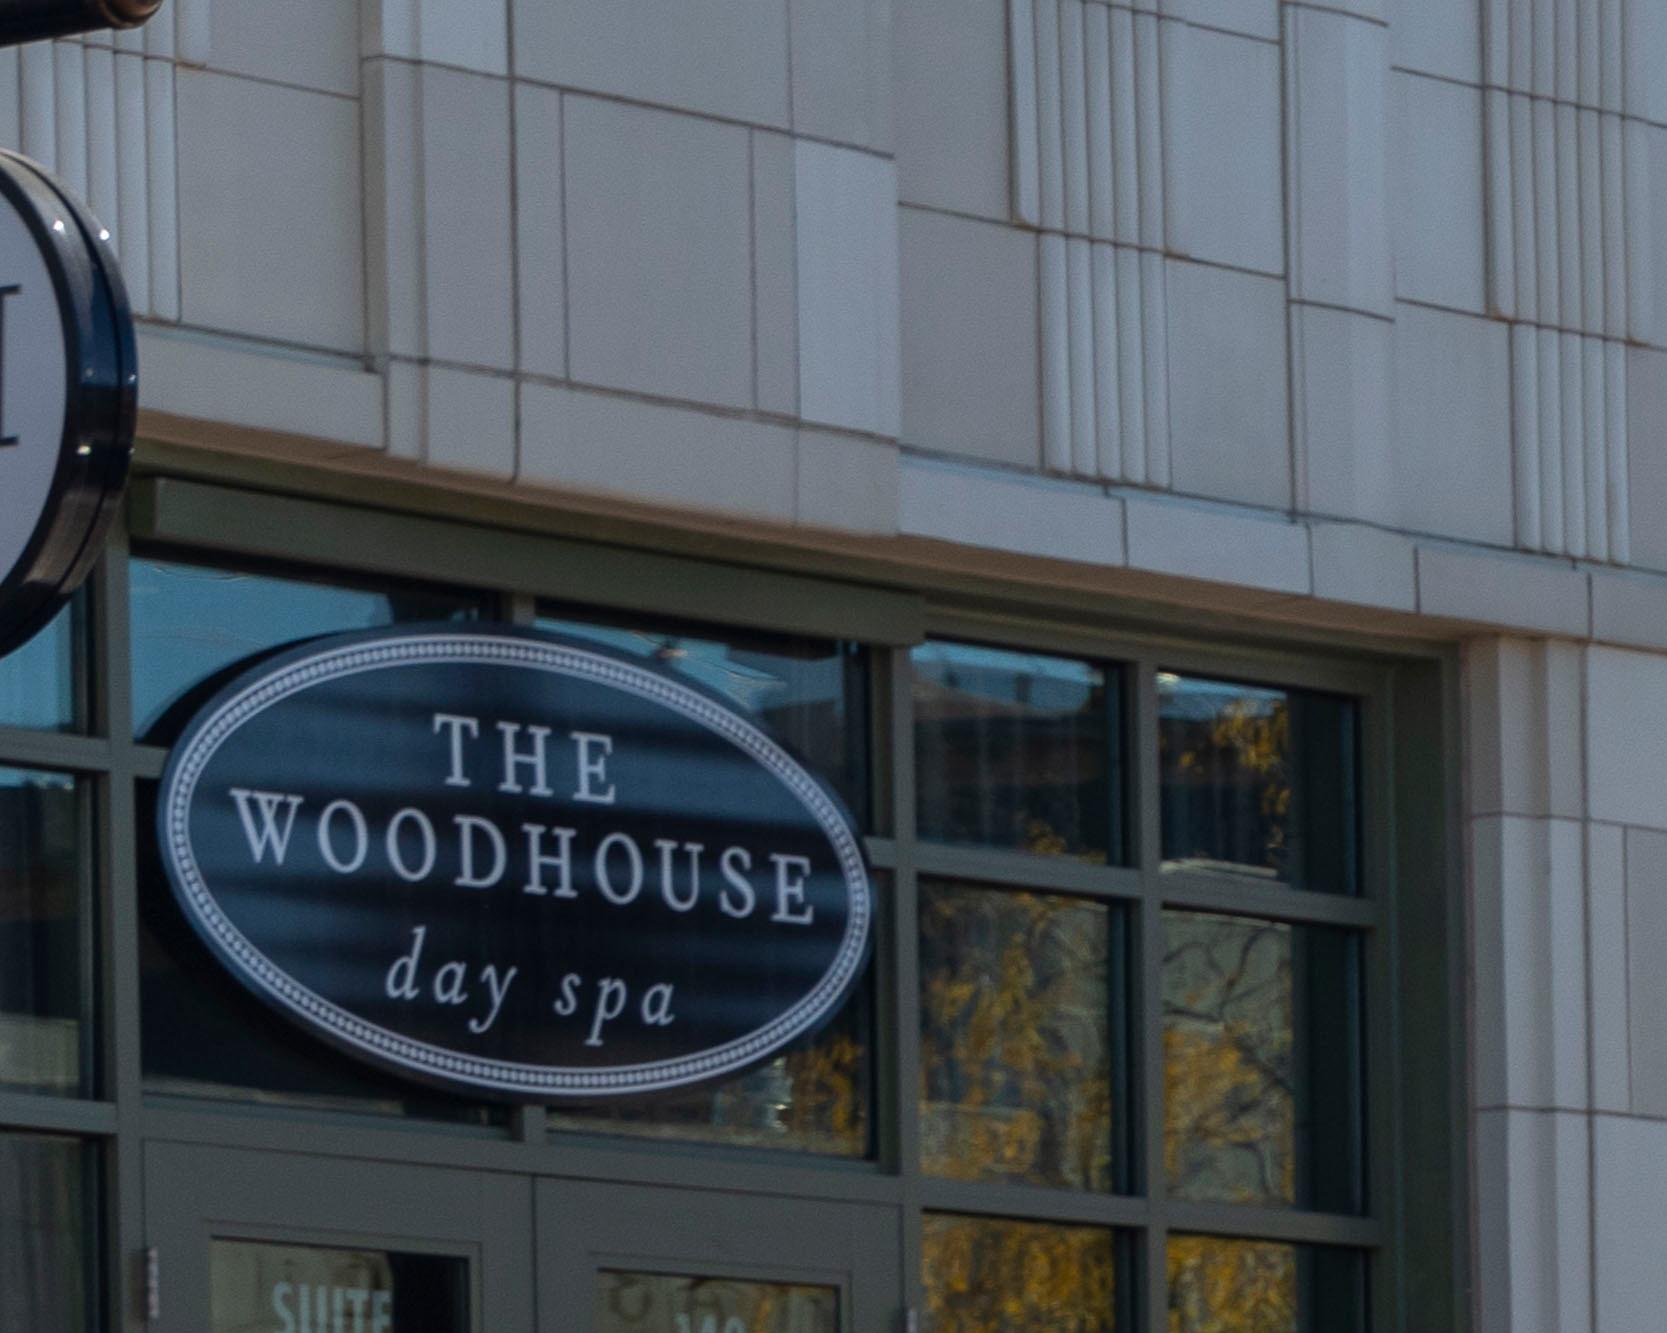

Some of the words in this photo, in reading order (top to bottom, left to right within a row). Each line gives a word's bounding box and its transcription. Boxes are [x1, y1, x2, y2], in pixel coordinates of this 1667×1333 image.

[433, 713, 616, 804] THE
[229, 788, 815, 925] WOODHOUSE
[385, 925, 519, 1034] day
[552, 973, 676, 1046] spa
